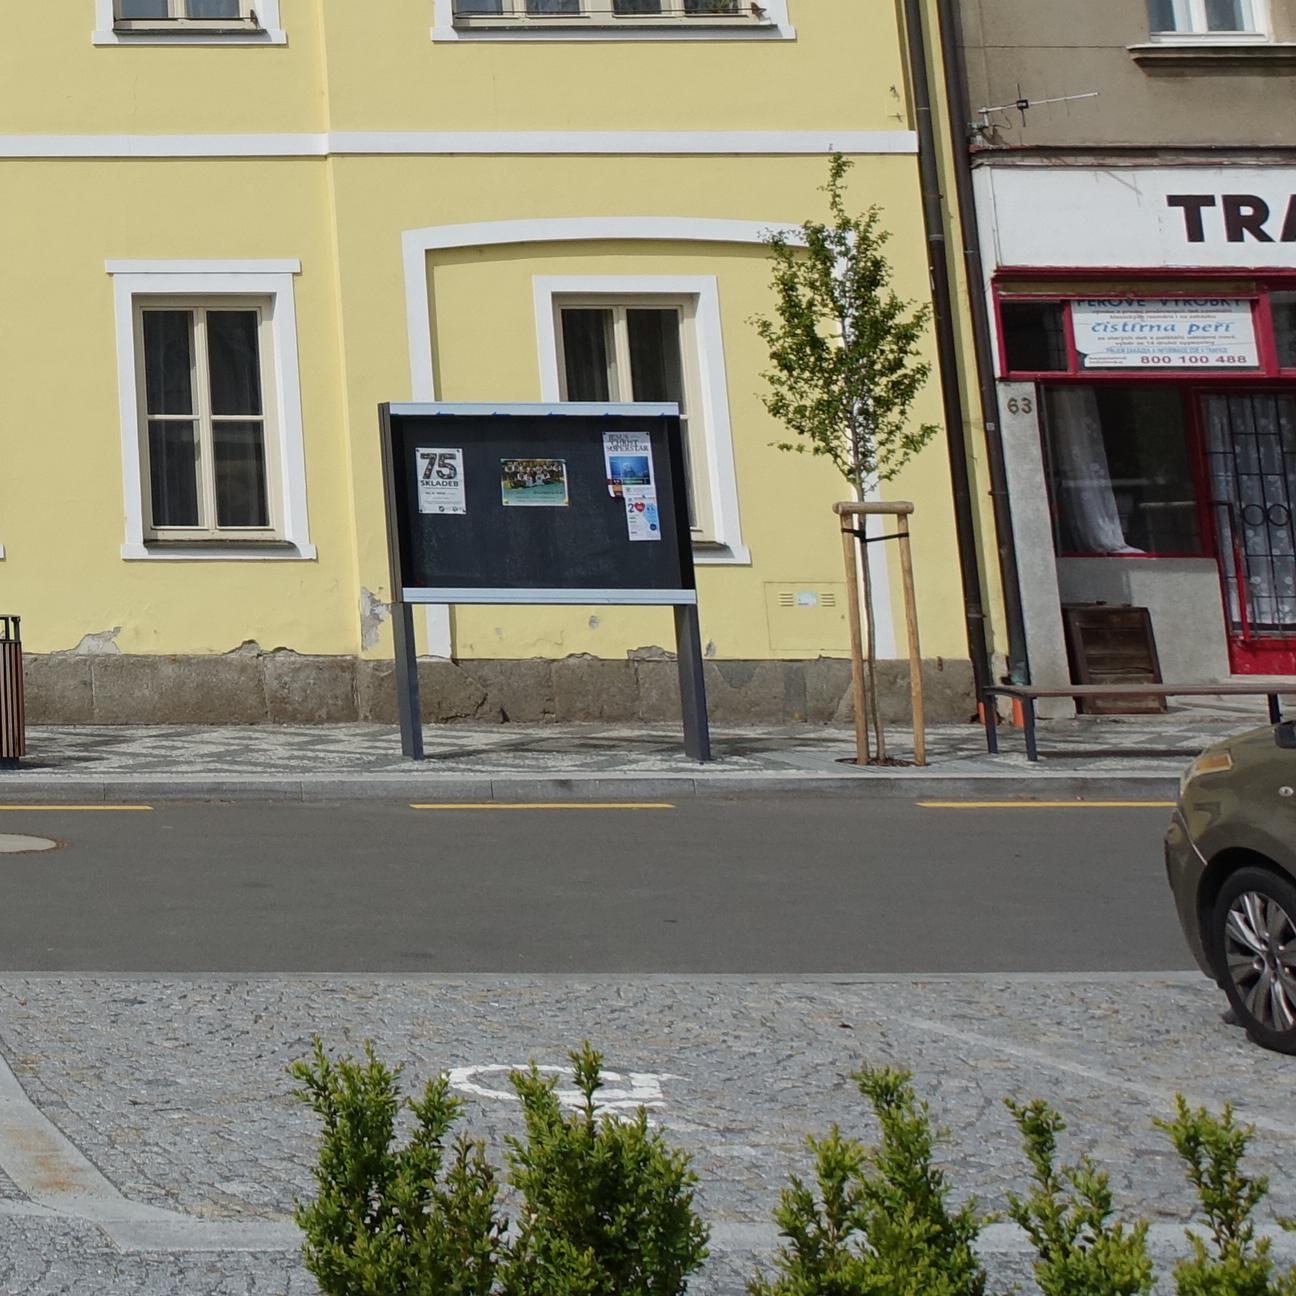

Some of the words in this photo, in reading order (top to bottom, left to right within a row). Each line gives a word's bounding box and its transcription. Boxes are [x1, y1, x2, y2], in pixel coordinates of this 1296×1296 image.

[1091, 320, 1176, 333] čistírna
[1187, 321, 1235, 335] peří
[1140, 355, 1172, 364] 800
[1179, 355, 1209, 364] 100
[1215, 355, 1248, 364] 488
[1007, 397, 1032, 415] 63
[420, 453, 457, 479] 75
